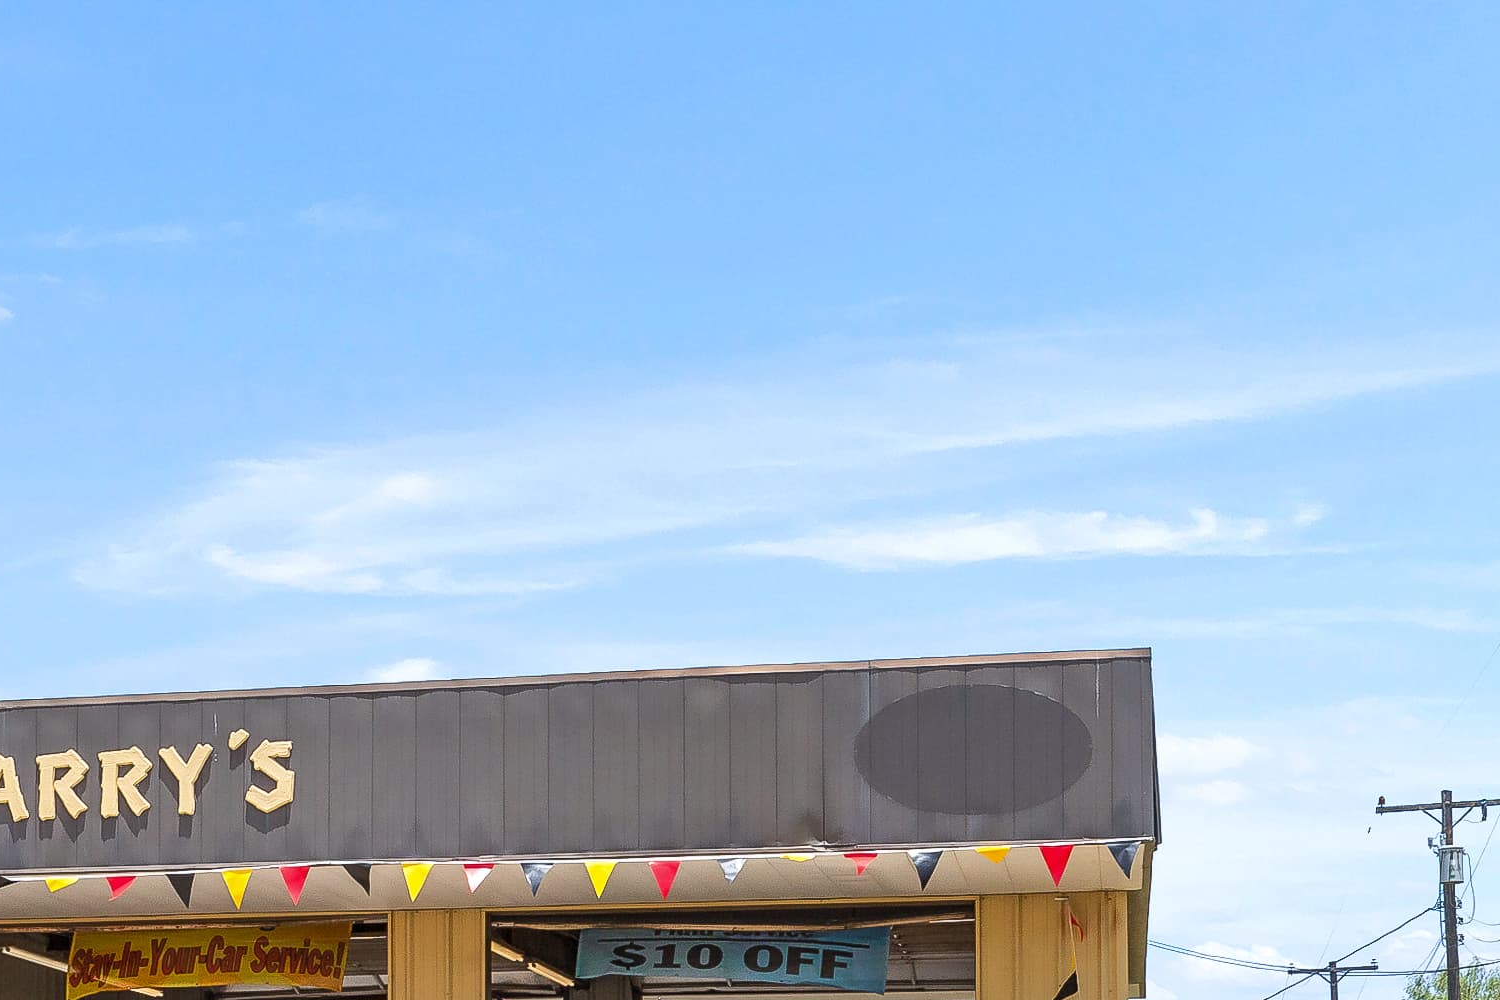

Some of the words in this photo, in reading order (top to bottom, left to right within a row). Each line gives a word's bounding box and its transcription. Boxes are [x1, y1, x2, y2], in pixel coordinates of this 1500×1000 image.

[250, 936, 346, 979] Service!
[610, 941, 724, 971] $10
[742, 944, 854, 980] OFF
